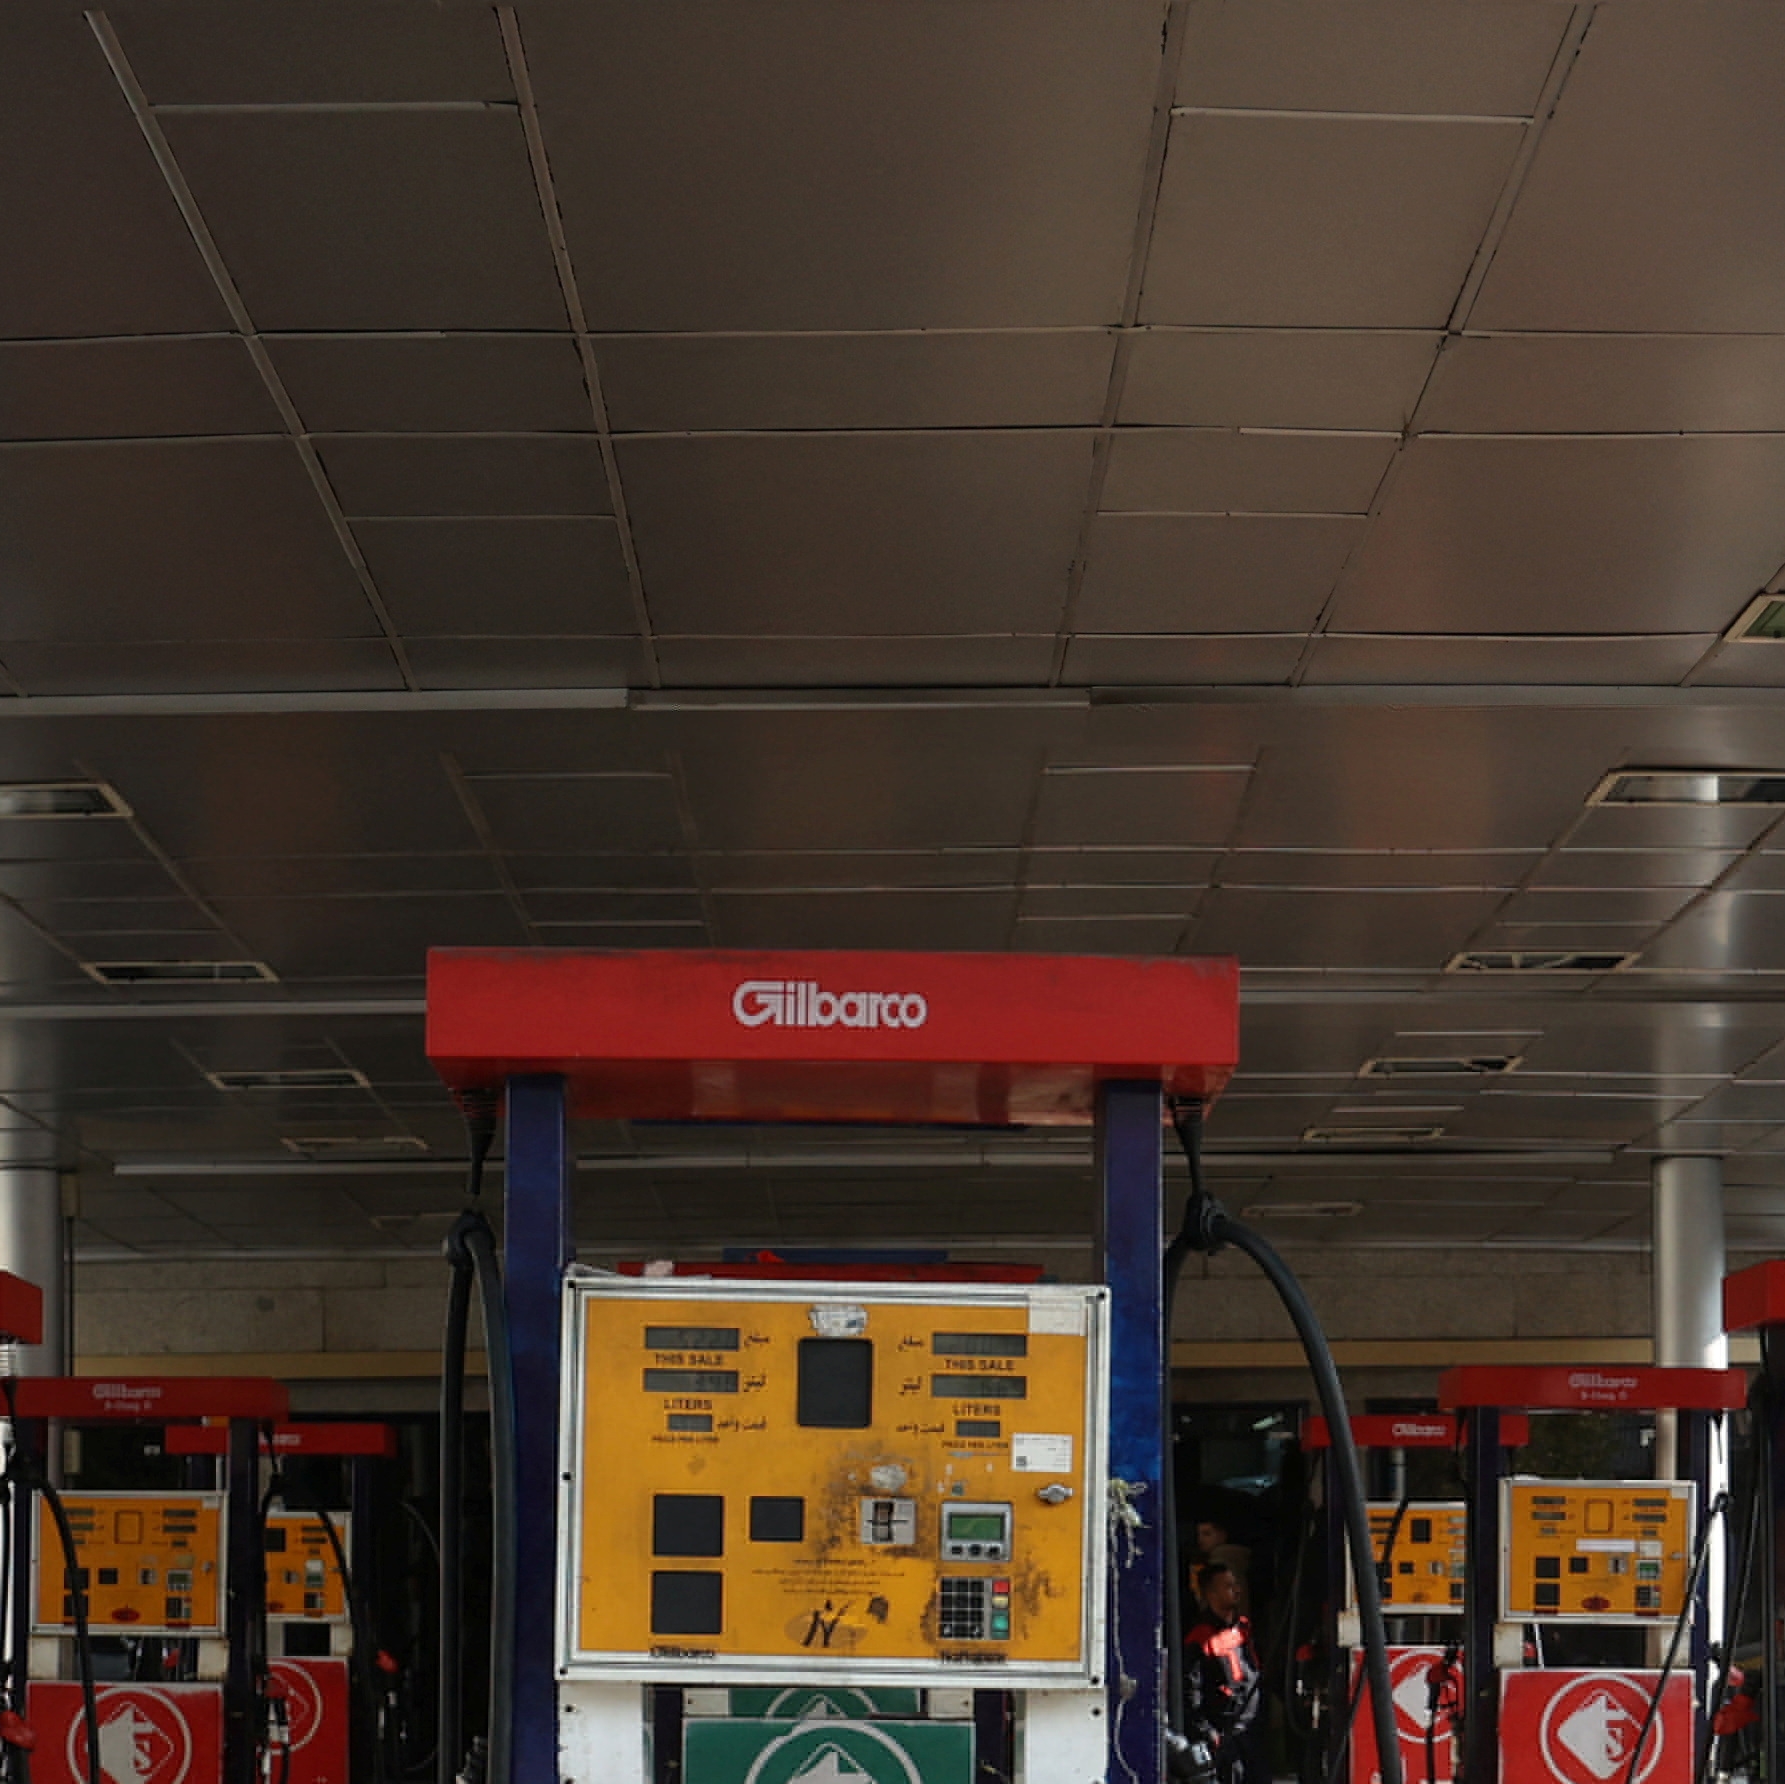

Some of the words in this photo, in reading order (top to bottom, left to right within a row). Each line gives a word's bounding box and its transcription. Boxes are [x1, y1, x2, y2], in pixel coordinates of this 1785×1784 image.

[732, 980, 928, 1028] Gilbarco
[655, 1353, 684, 1365] THIS
[687, 1353, 723, 1365] SALE
[944, 1360, 974, 1370] THIS
[978, 1360, 1015, 1370] SALE
[663, 1399, 712, 1411] LITERS
[953, 1404, 1001, 1417] LITERS
